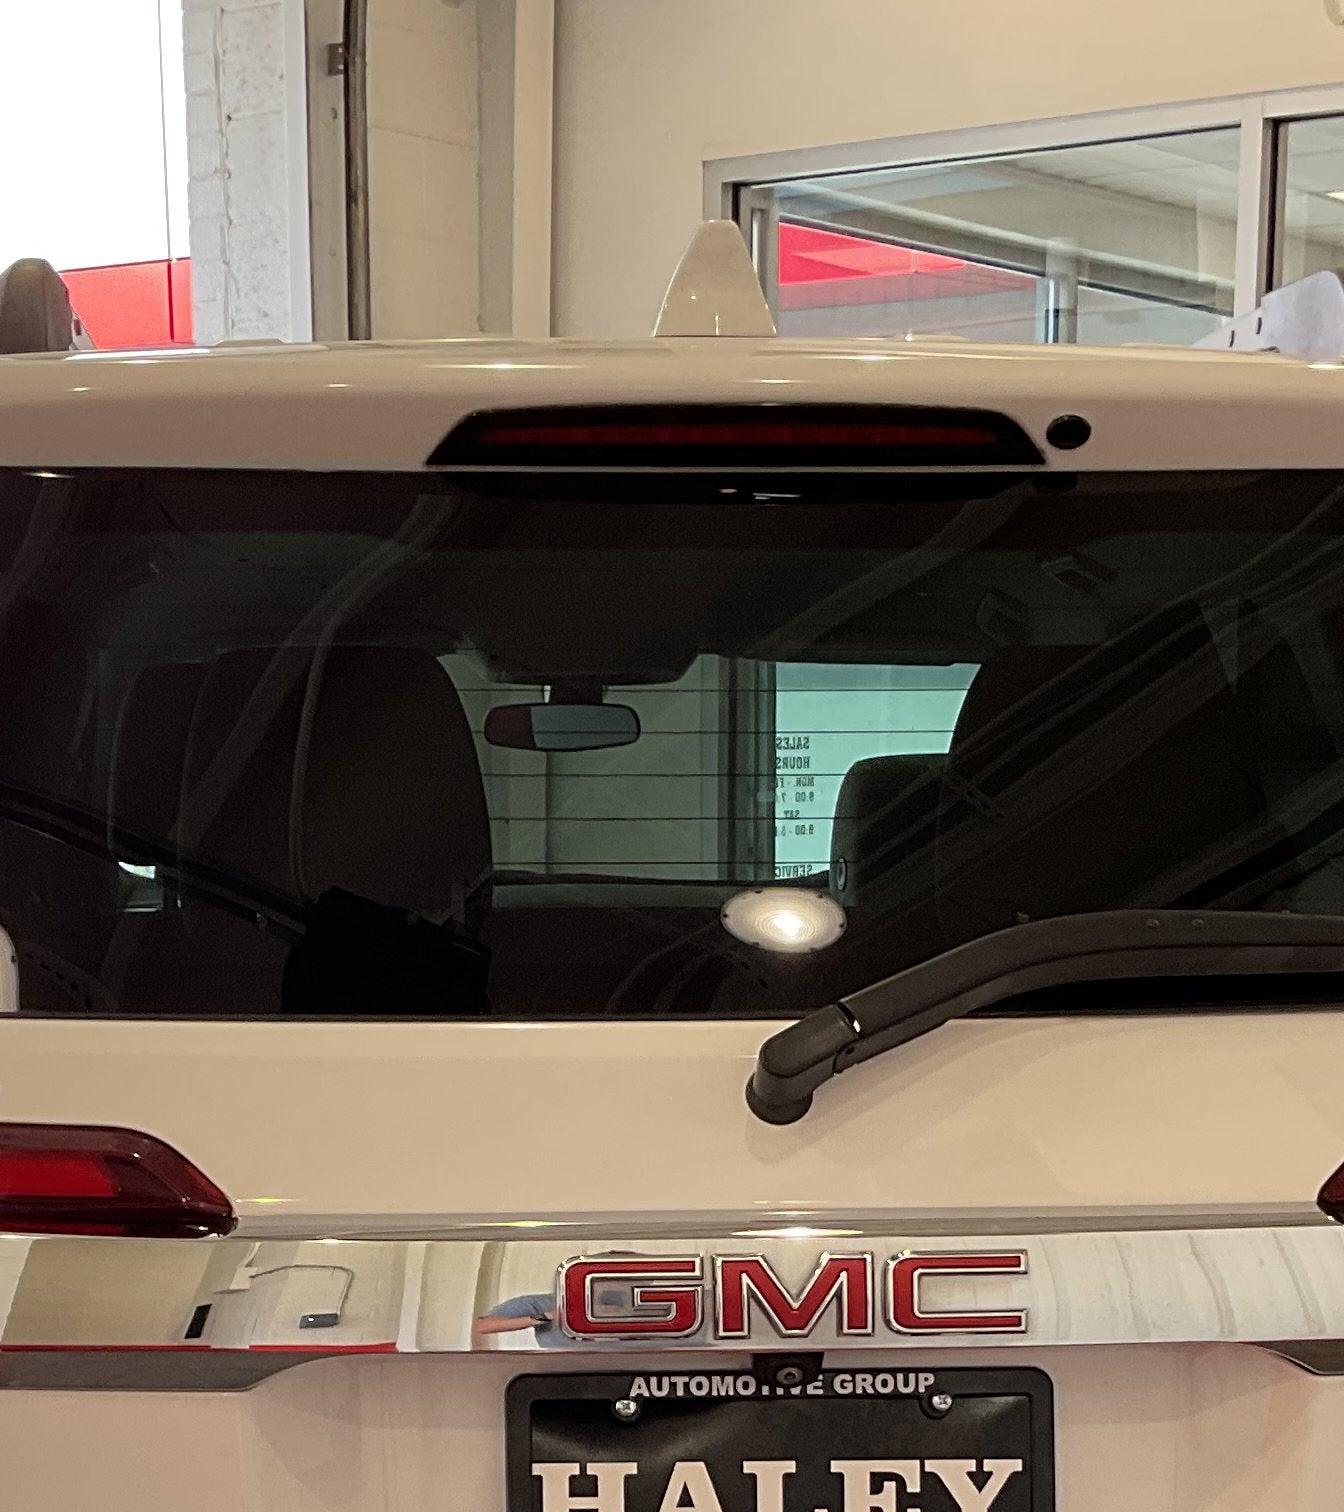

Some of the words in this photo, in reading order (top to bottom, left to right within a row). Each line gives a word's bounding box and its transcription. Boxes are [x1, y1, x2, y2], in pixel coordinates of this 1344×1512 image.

[557, 1250, 1028, 1339] GMC
[629, 1374, 824, 1397] AUTOMOE
[833, 1372, 935, 1395] GROUP
